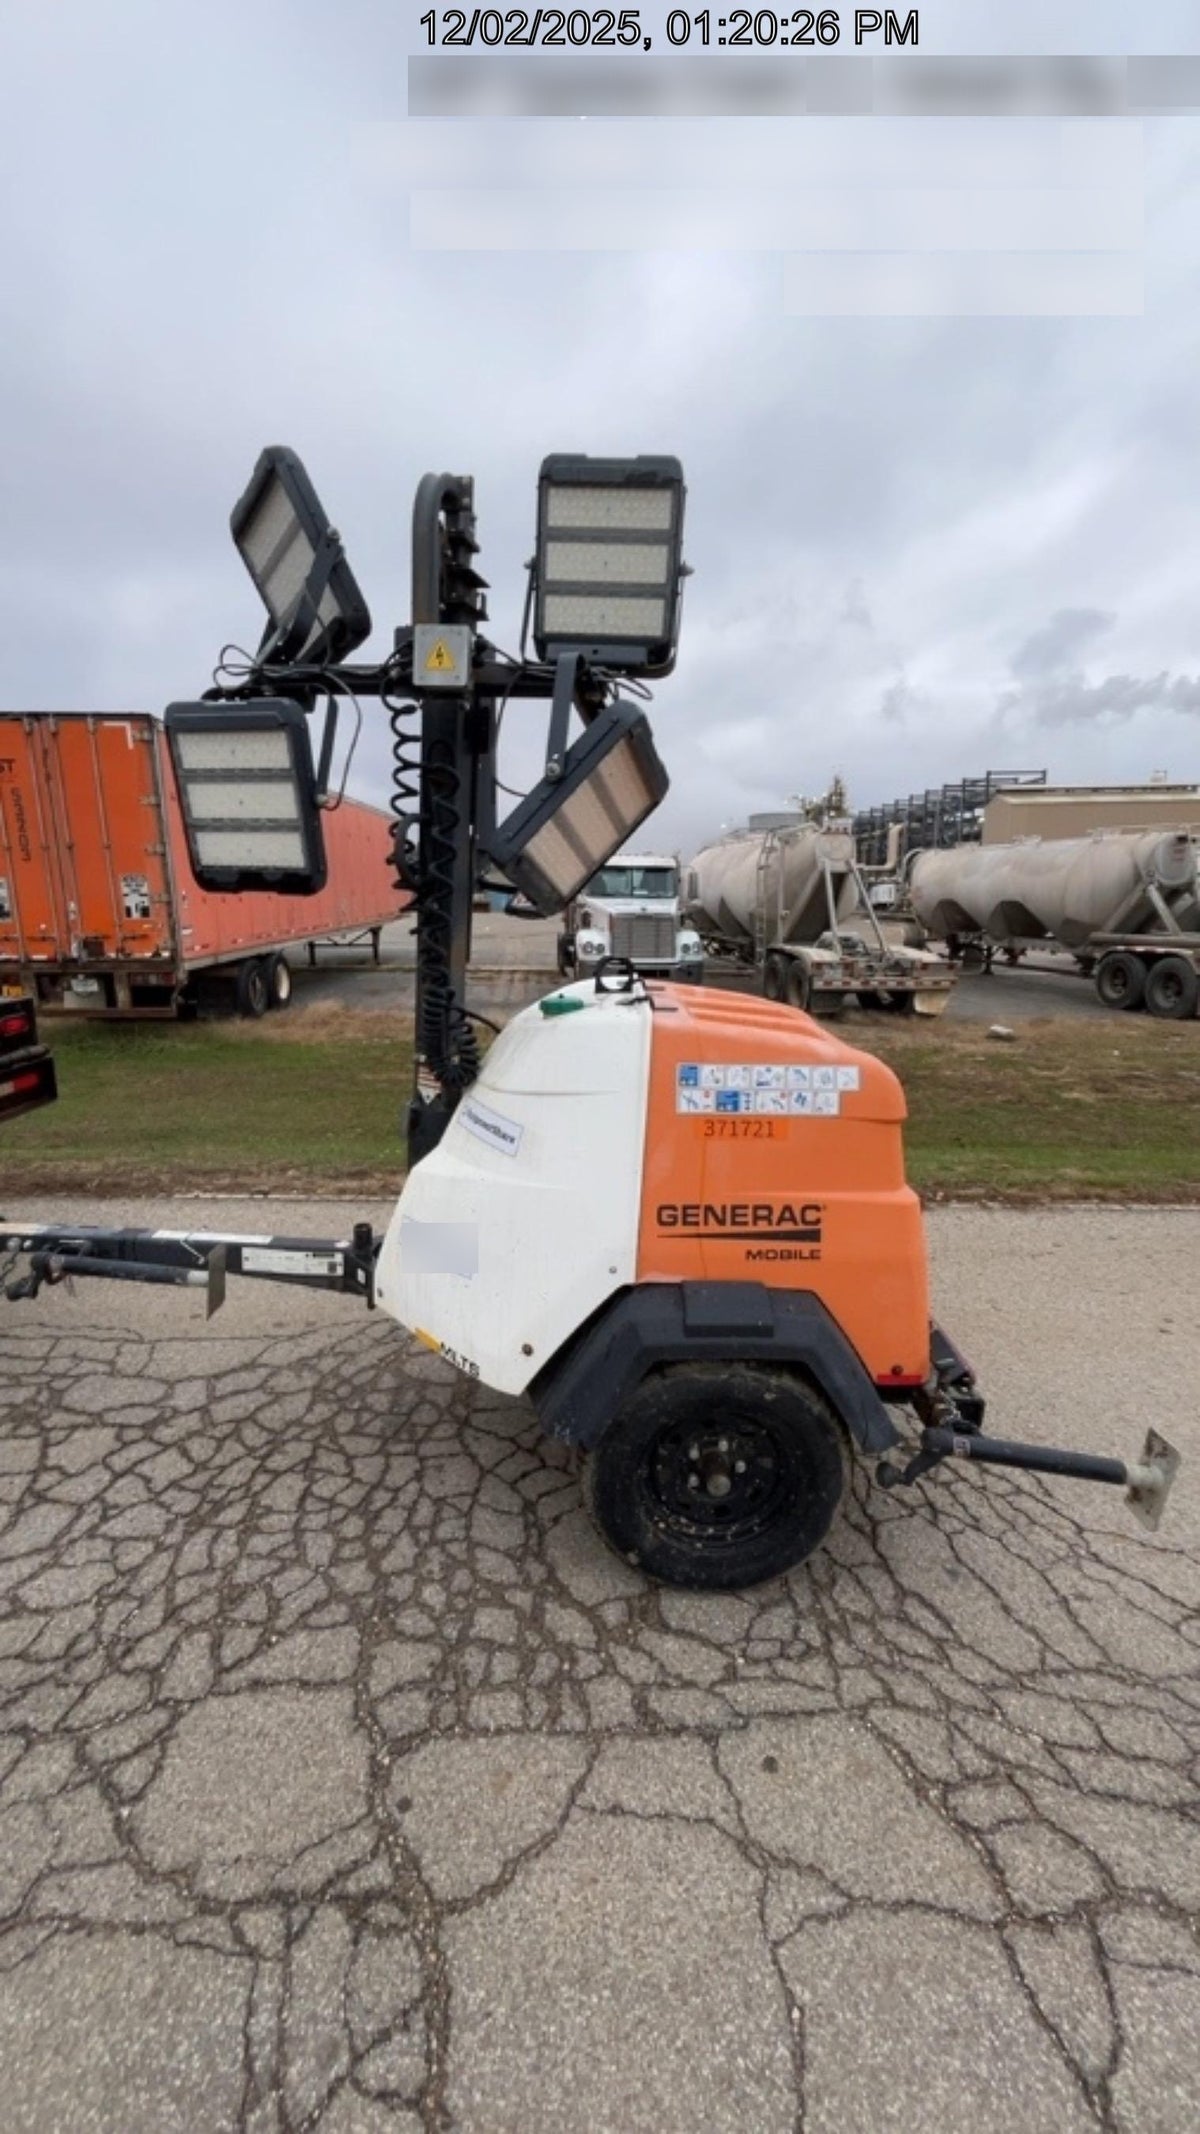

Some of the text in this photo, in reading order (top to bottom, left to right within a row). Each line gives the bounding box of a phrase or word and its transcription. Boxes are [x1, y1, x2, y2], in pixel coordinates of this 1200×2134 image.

[703, 1118, 774, 1138] 371721
[656, 1204, 822, 1227] GENERAC
[745, 1248, 822, 1260] MOBILE
